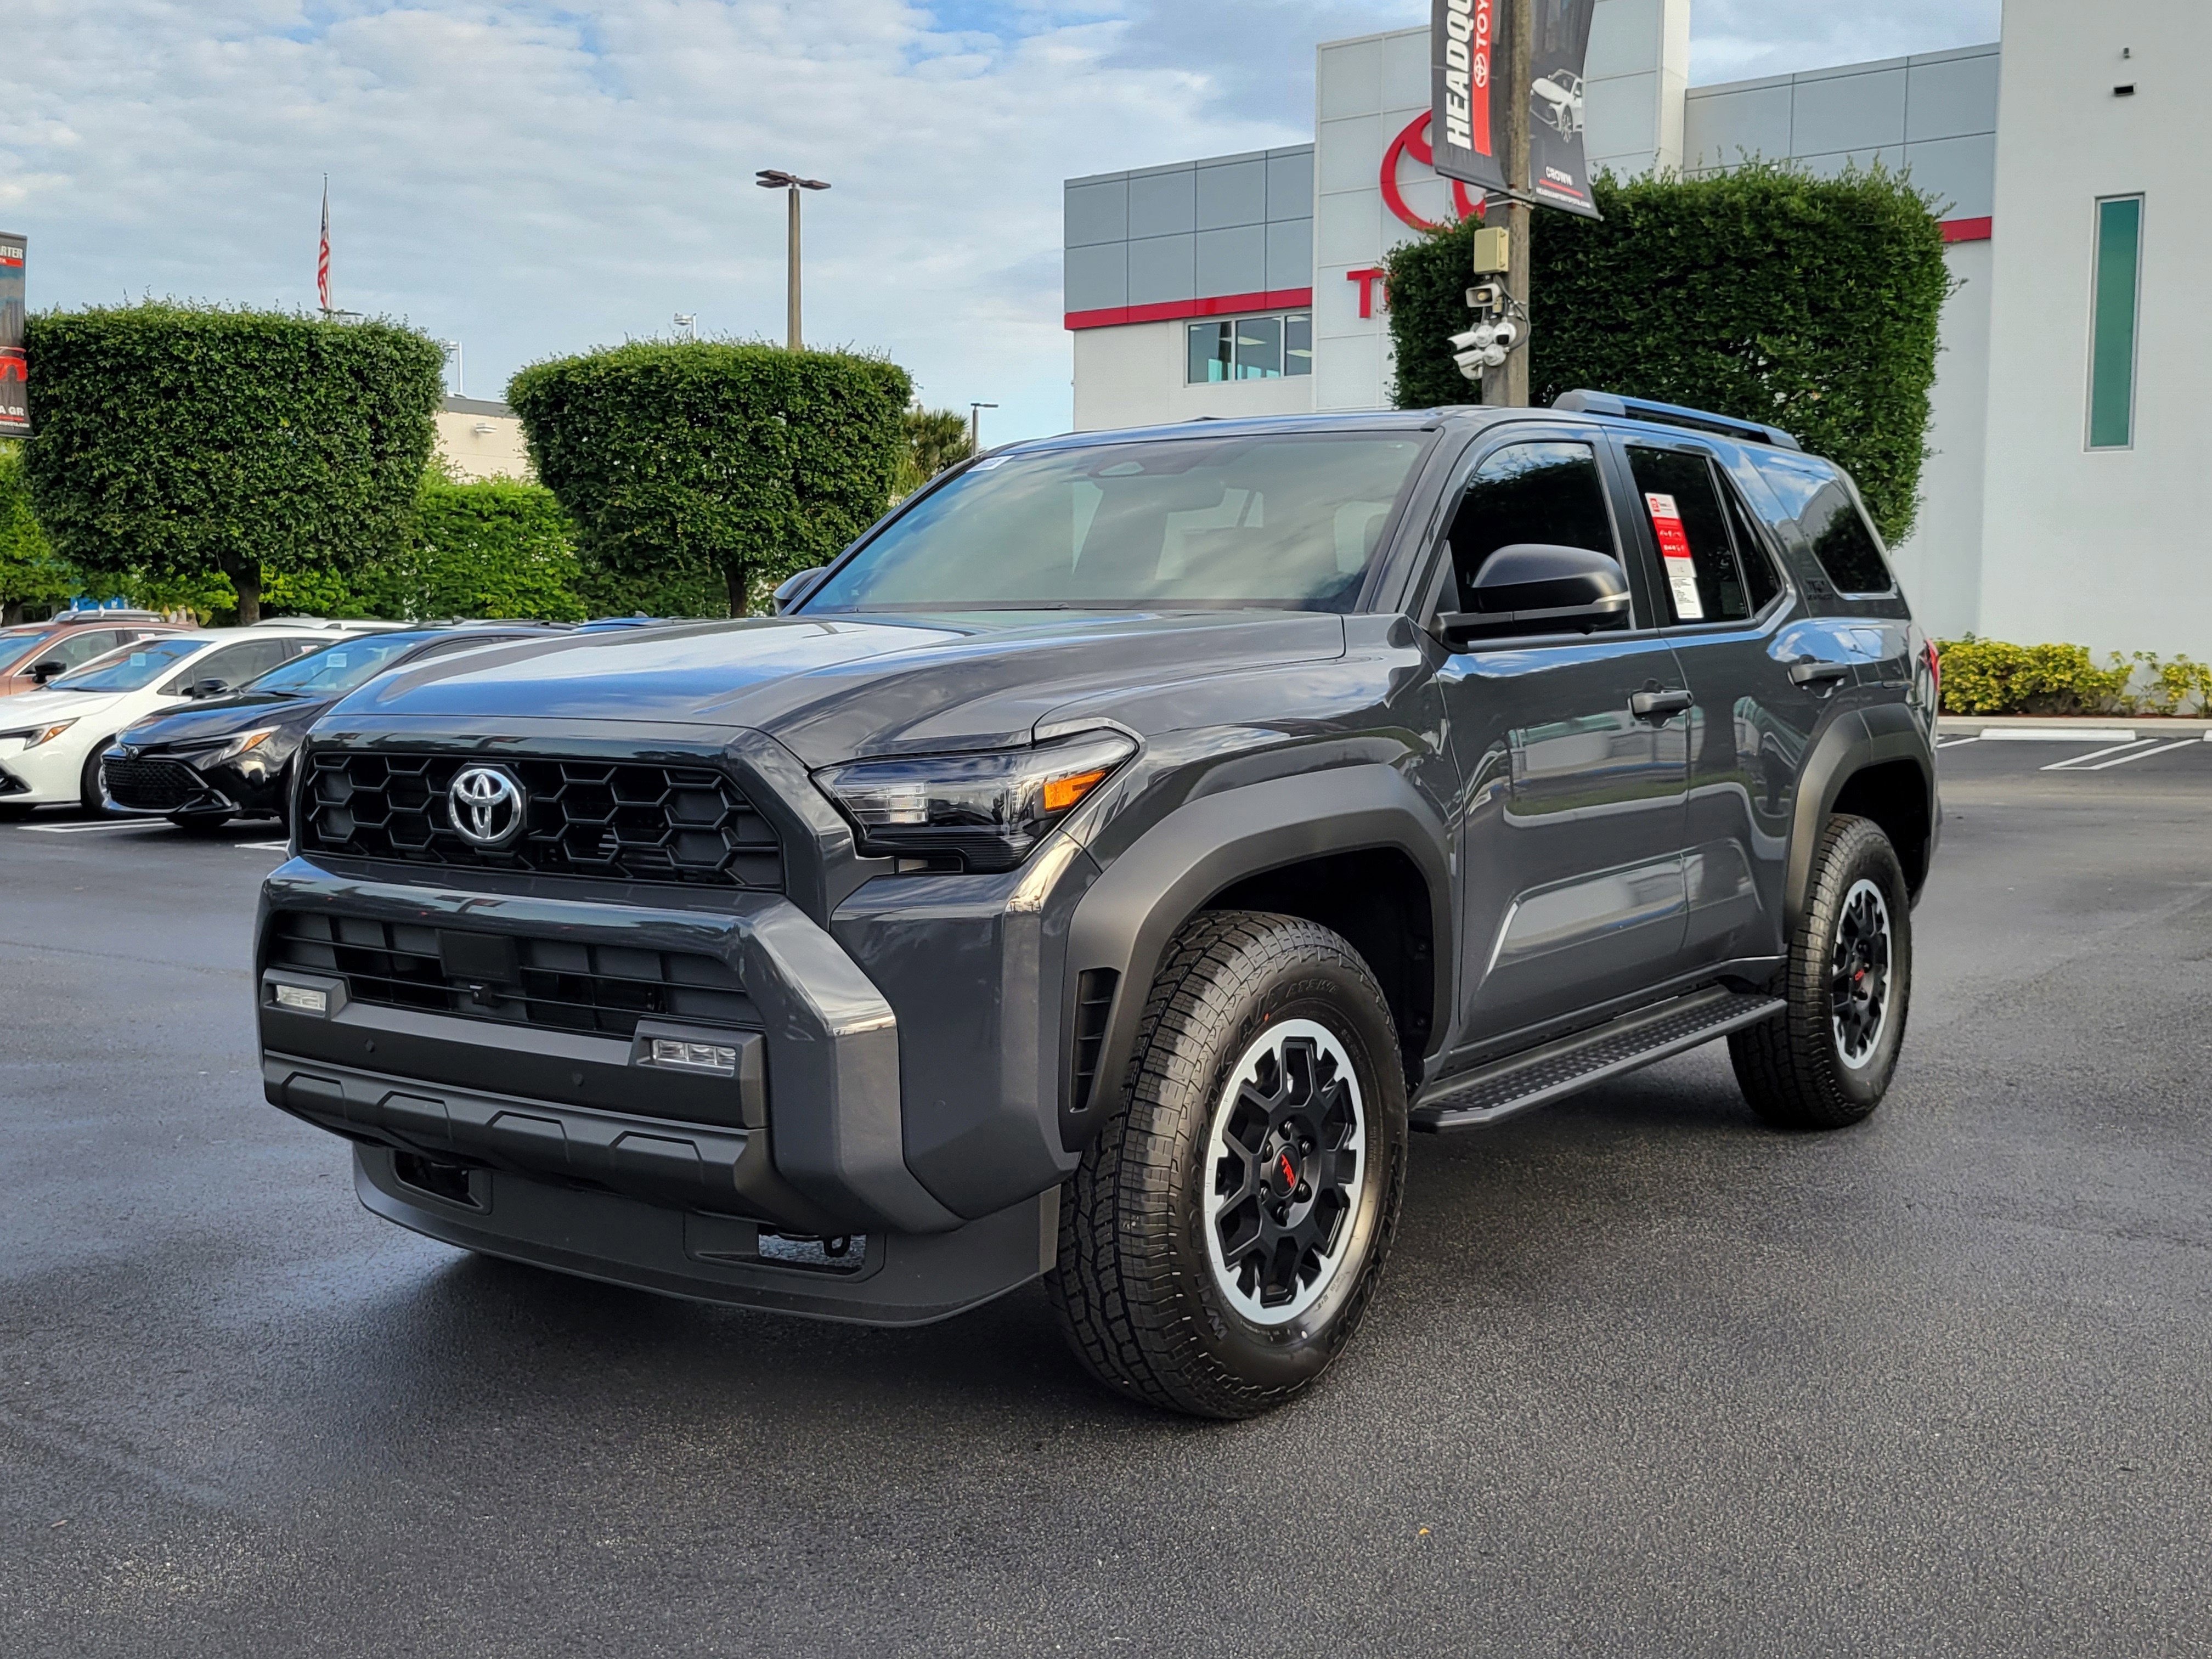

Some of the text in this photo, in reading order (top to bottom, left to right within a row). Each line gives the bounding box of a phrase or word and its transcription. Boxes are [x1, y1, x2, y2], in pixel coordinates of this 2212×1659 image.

[1545, 166, 1573, 187] CROWN
[8, 406, 25, 416] GR
[1281, 1153, 1296, 1189] TRD
